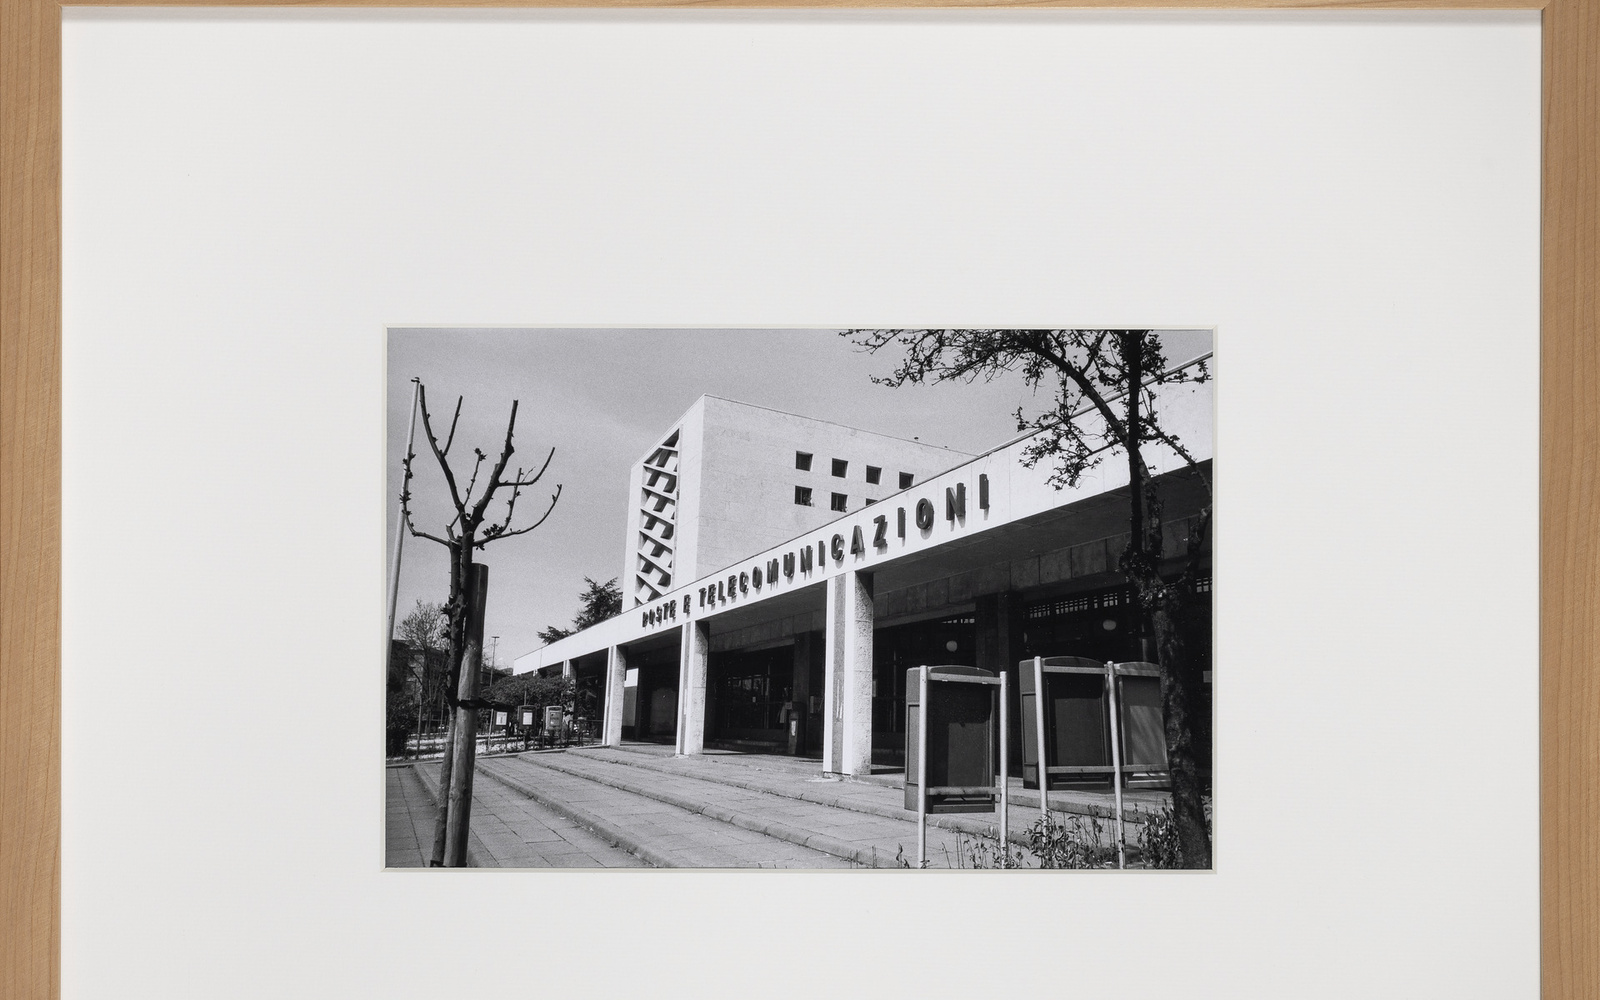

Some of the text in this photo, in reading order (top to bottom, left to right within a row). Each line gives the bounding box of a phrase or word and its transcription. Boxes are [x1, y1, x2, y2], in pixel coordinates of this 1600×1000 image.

[642, 473, 990, 628] POSTE E TELECOMUNICAZIONI
